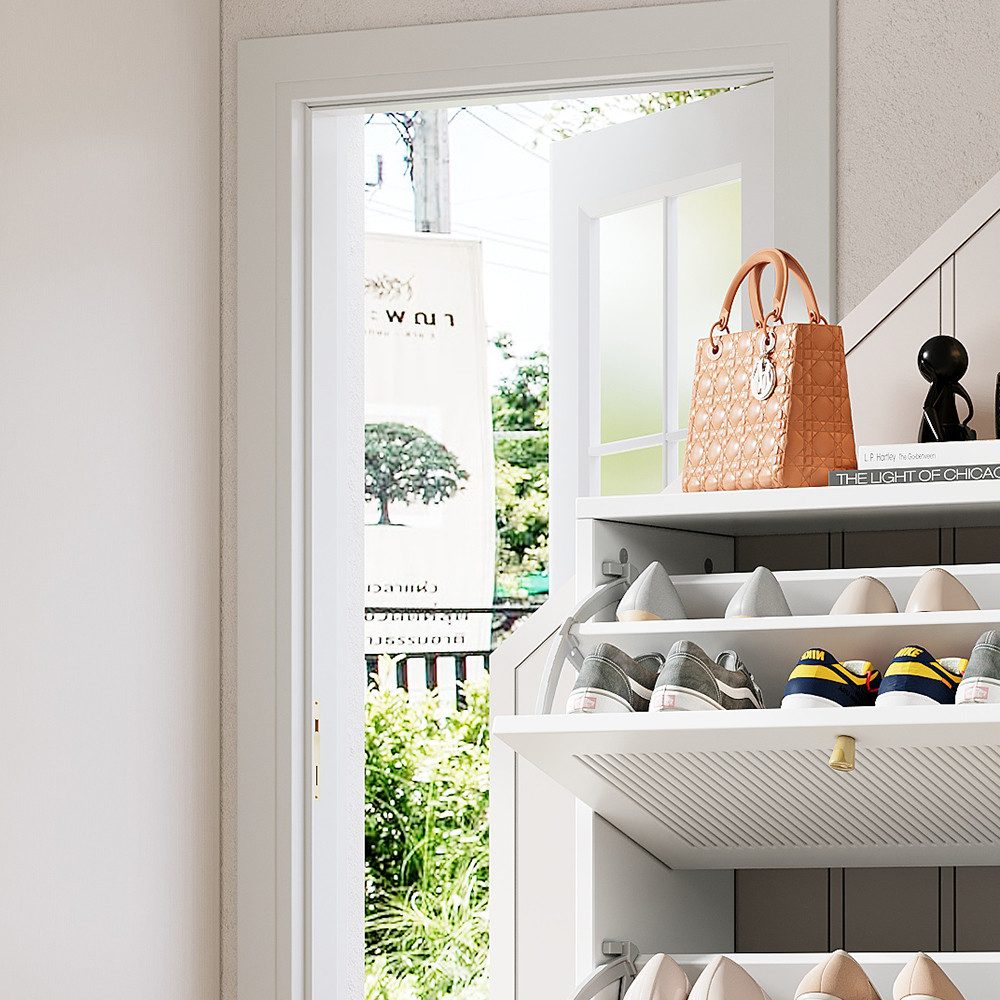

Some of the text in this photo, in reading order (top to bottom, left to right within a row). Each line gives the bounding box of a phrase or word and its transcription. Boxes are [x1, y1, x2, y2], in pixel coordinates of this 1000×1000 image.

[836, 472, 868, 485] THE
[870, 470, 917, 484] LIGHT
[918, 469, 941, 482] OF
[894, 647, 924, 659] NIKE
